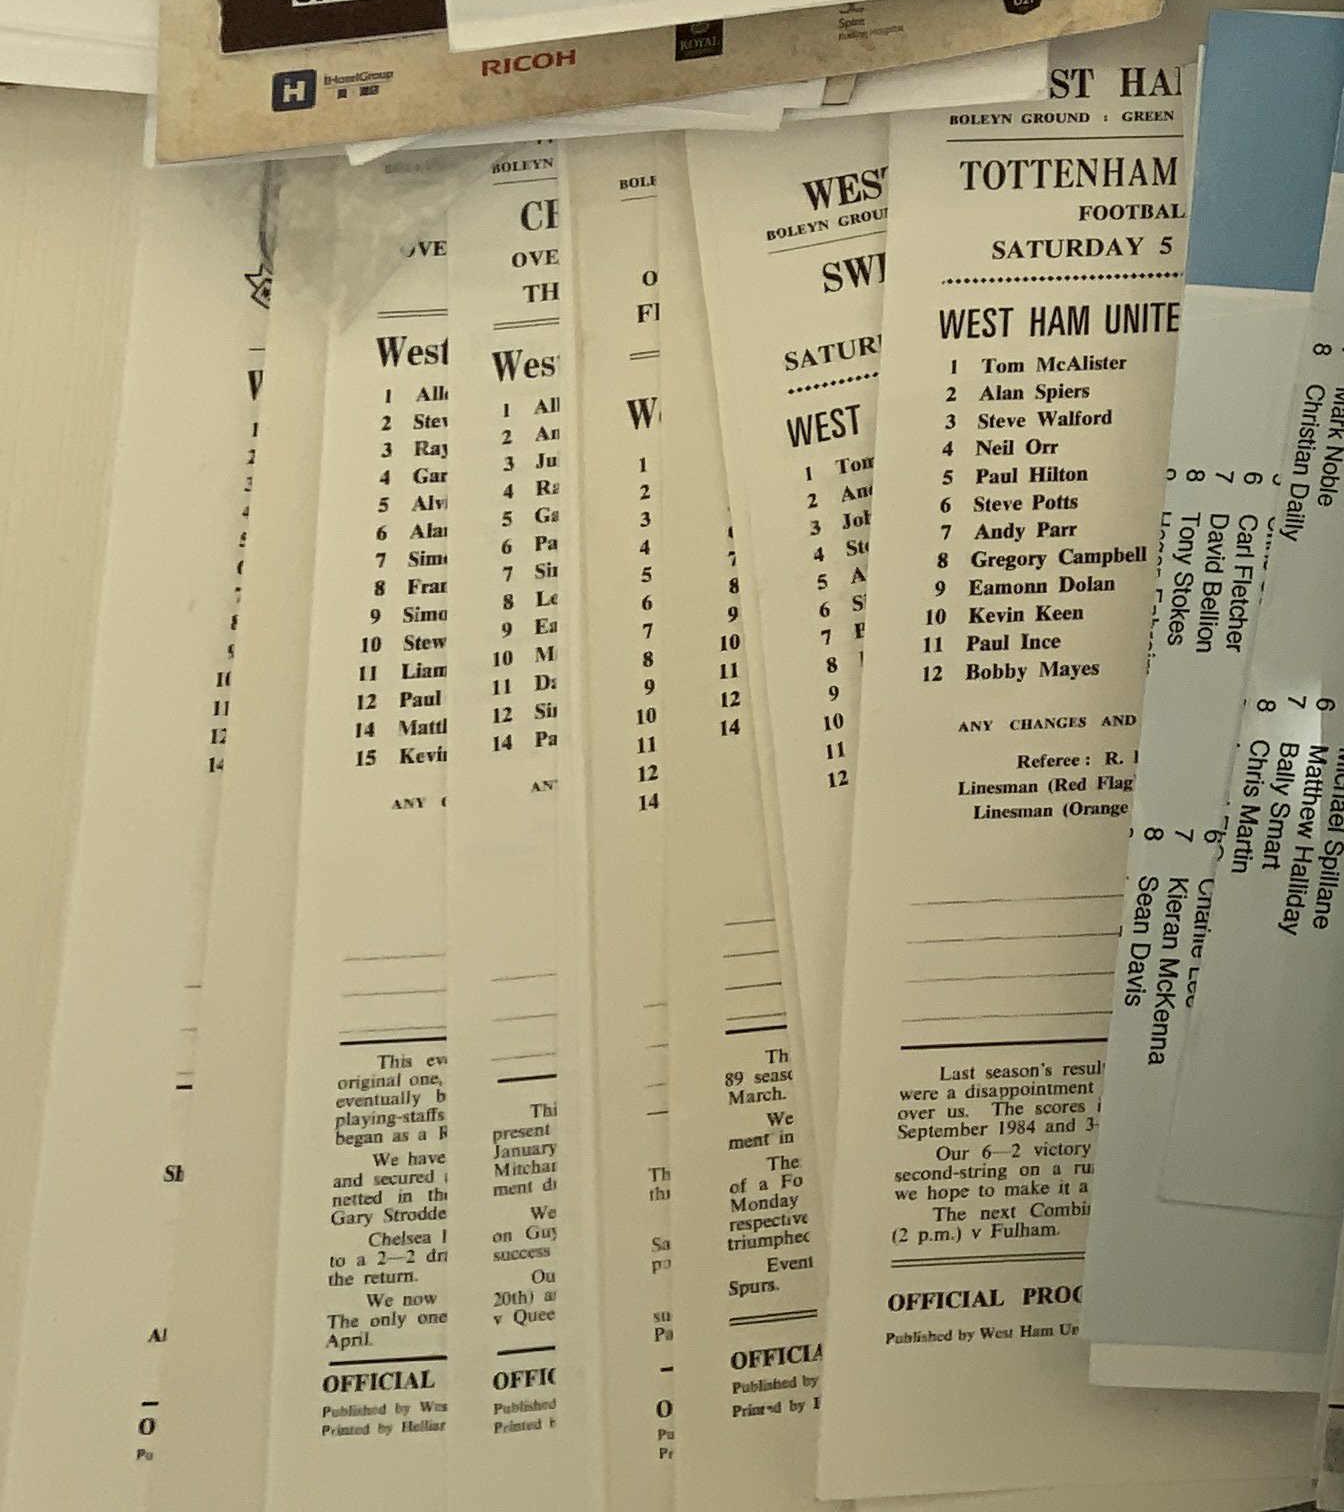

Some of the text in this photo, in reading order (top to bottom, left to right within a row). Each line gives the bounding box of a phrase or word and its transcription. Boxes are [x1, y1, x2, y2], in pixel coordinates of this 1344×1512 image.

[482, 49, 575, 77] RICOH
[960, 157, 1177, 190] TOTTENHAM
[992, 236, 1172, 259] SATURDAY 5
[940, 305, 1089, 339] WEST HAM
[982, 355, 1127, 373] Tom McAlister
[979, 383, 1089, 403] Alan Spiers
[978, 409, 1112, 429] Steve Walford
[976, 439, 1058, 455] Neil Orr
[976, 466, 1087, 484] Paul Hilton
[1317, 446, 1344, 506] Noble
[1167, 512, 1201, 645] Tony Stokes
[1196, 514, 1230, 652] David Bellion
[969, 605, 1083, 623] Kevin Keen
[967, 633, 1061, 651] Paul Ince
[966, 661, 1099, 682] Bobby Mayes
[1124, 876, 1159, 1006] Sean Davis
[986, 1062, 1052, 1079] season's
[336, 1090, 421, 1108] eventually
[729, 1086, 786, 1105] March.
[965, 1081, 1093, 1100] disappointment
[898, 1120, 1035, 1141] September 1984
[991, 1222, 1060, 1238] Fulham.
[888, 1289, 1004, 1311] OFFICIAL
[323, 1370, 435, 1393] OFFICIAL
